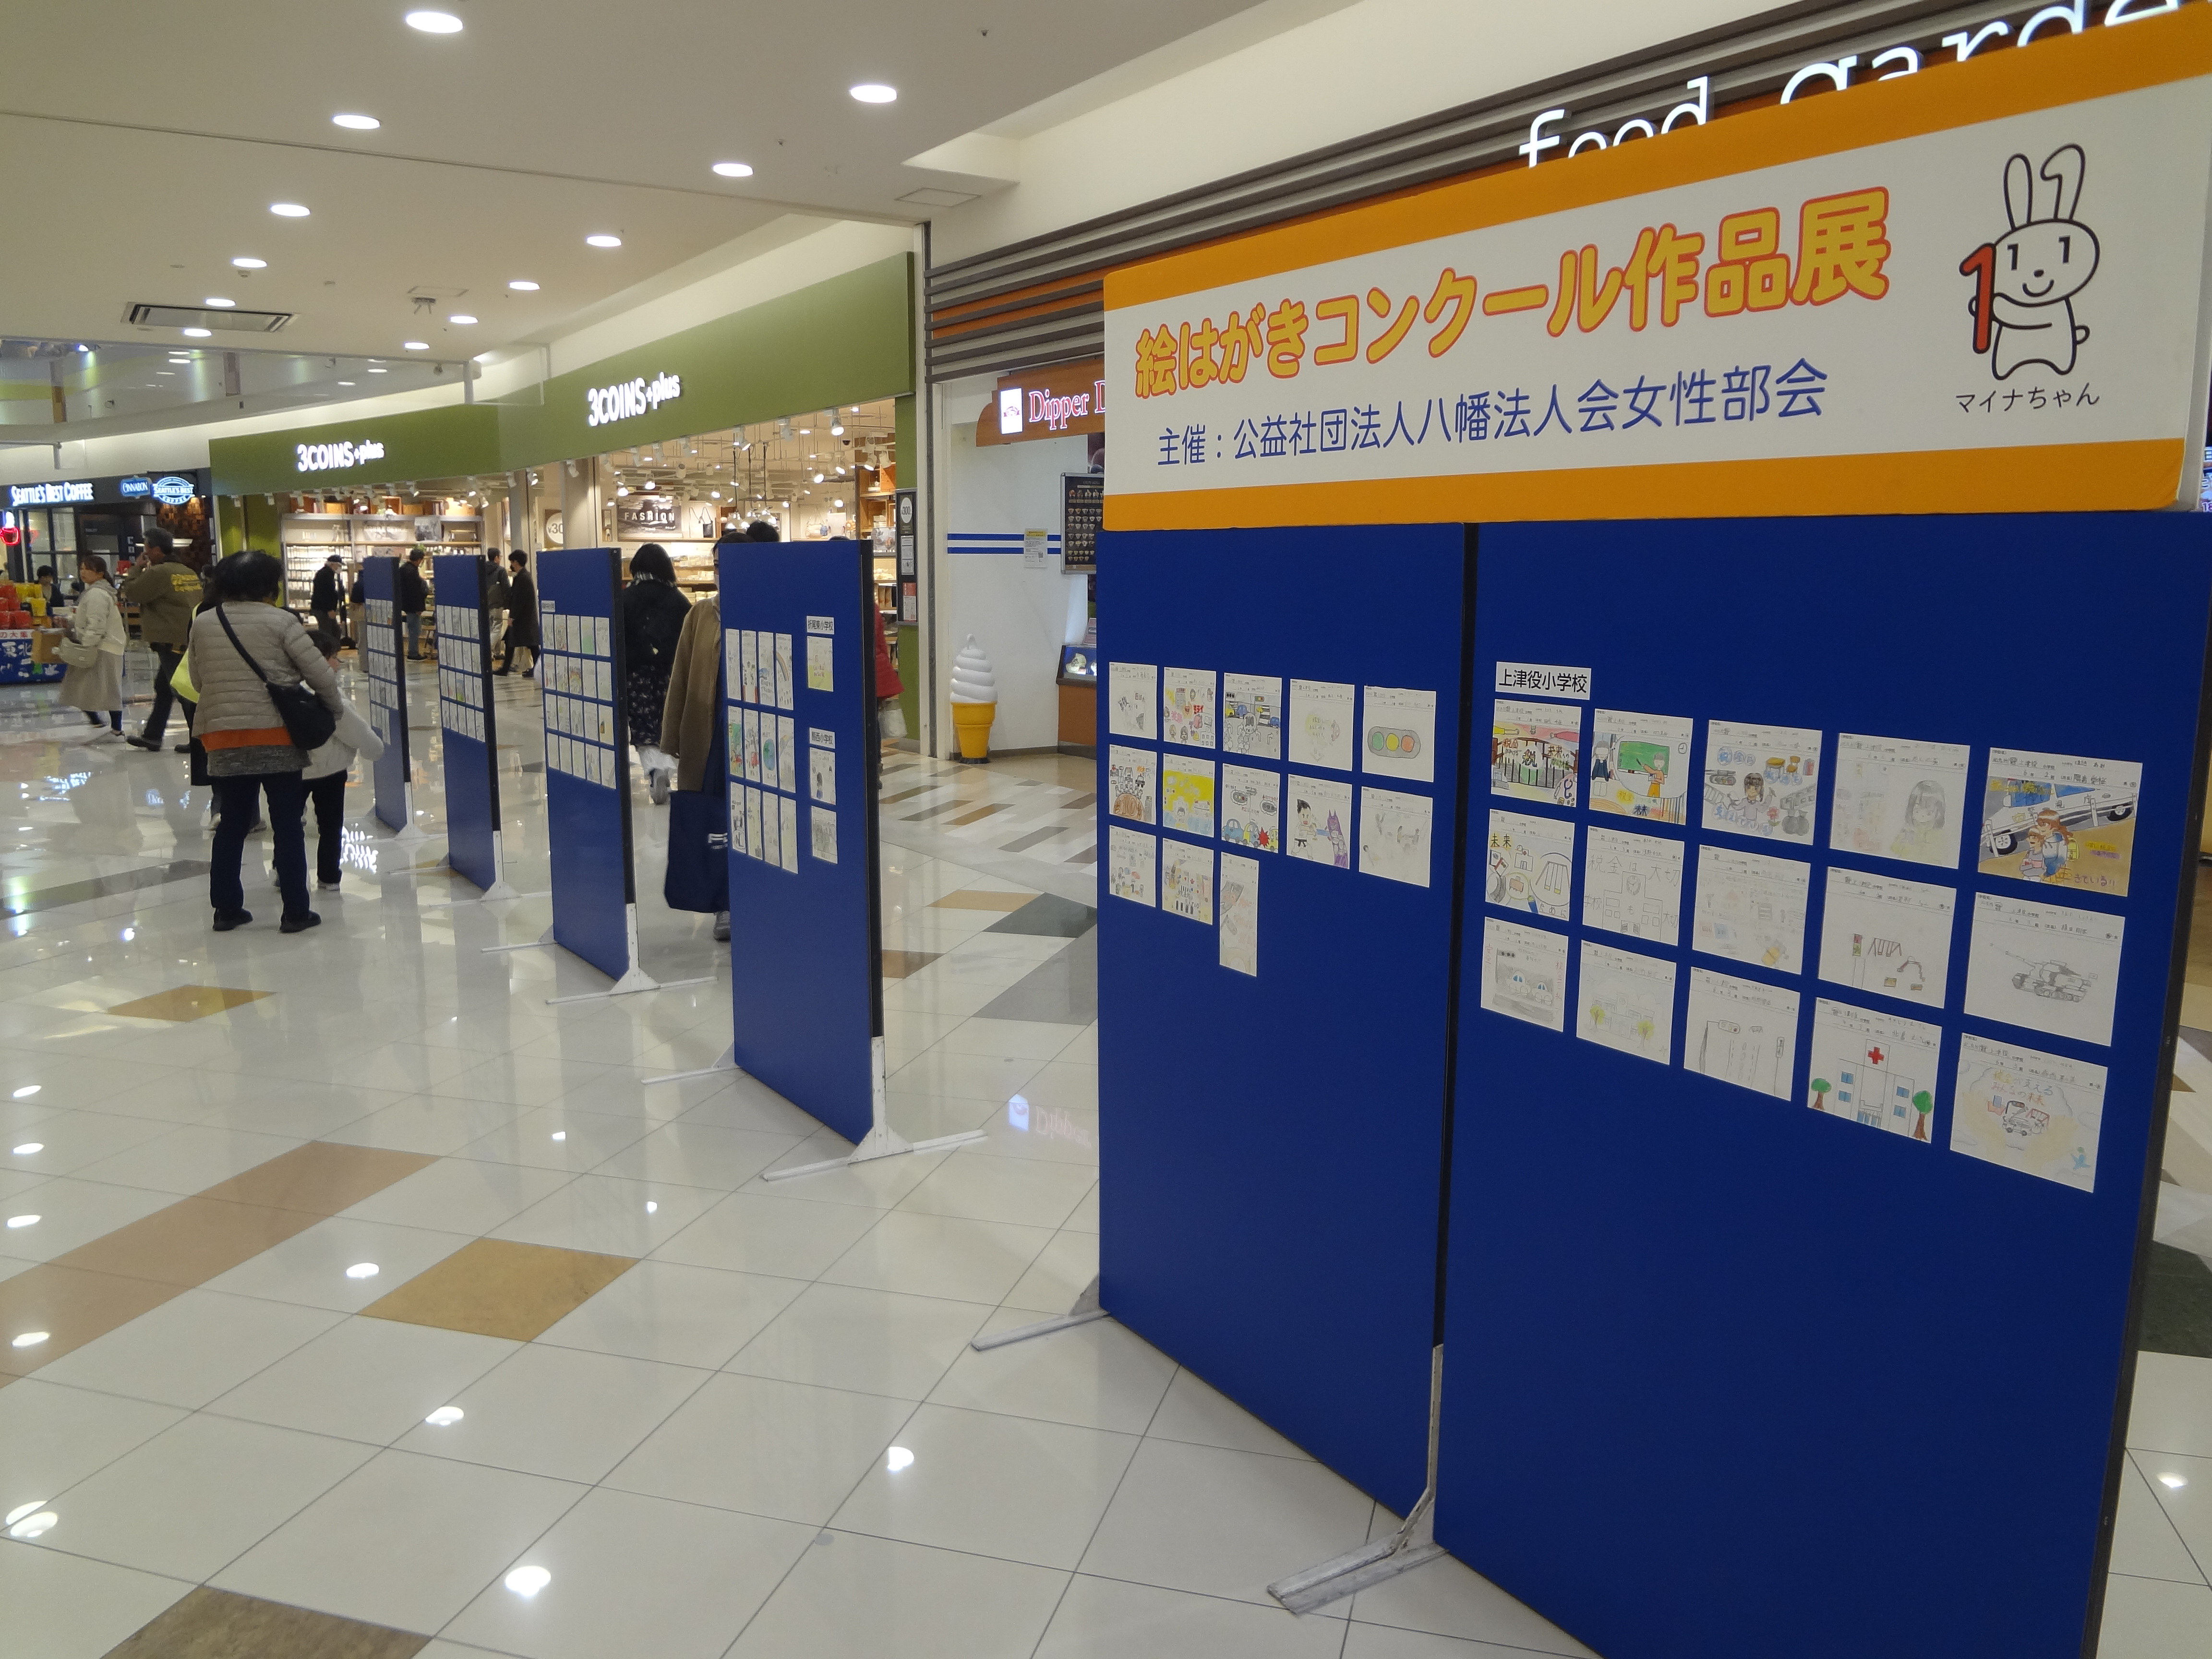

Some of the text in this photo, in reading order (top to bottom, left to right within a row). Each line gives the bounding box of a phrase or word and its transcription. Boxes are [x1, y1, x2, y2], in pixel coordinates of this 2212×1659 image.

[1134, 186, 1890, 400] 絵はがきコンクール作品展
[1029, 388, 1090, 431] Dipper
[1956, 383, 2101, 416] マイナちゃん
[1498, 668, 1588, 694] 上津役小学校
[1491, 833, 1512, 848] 未来
